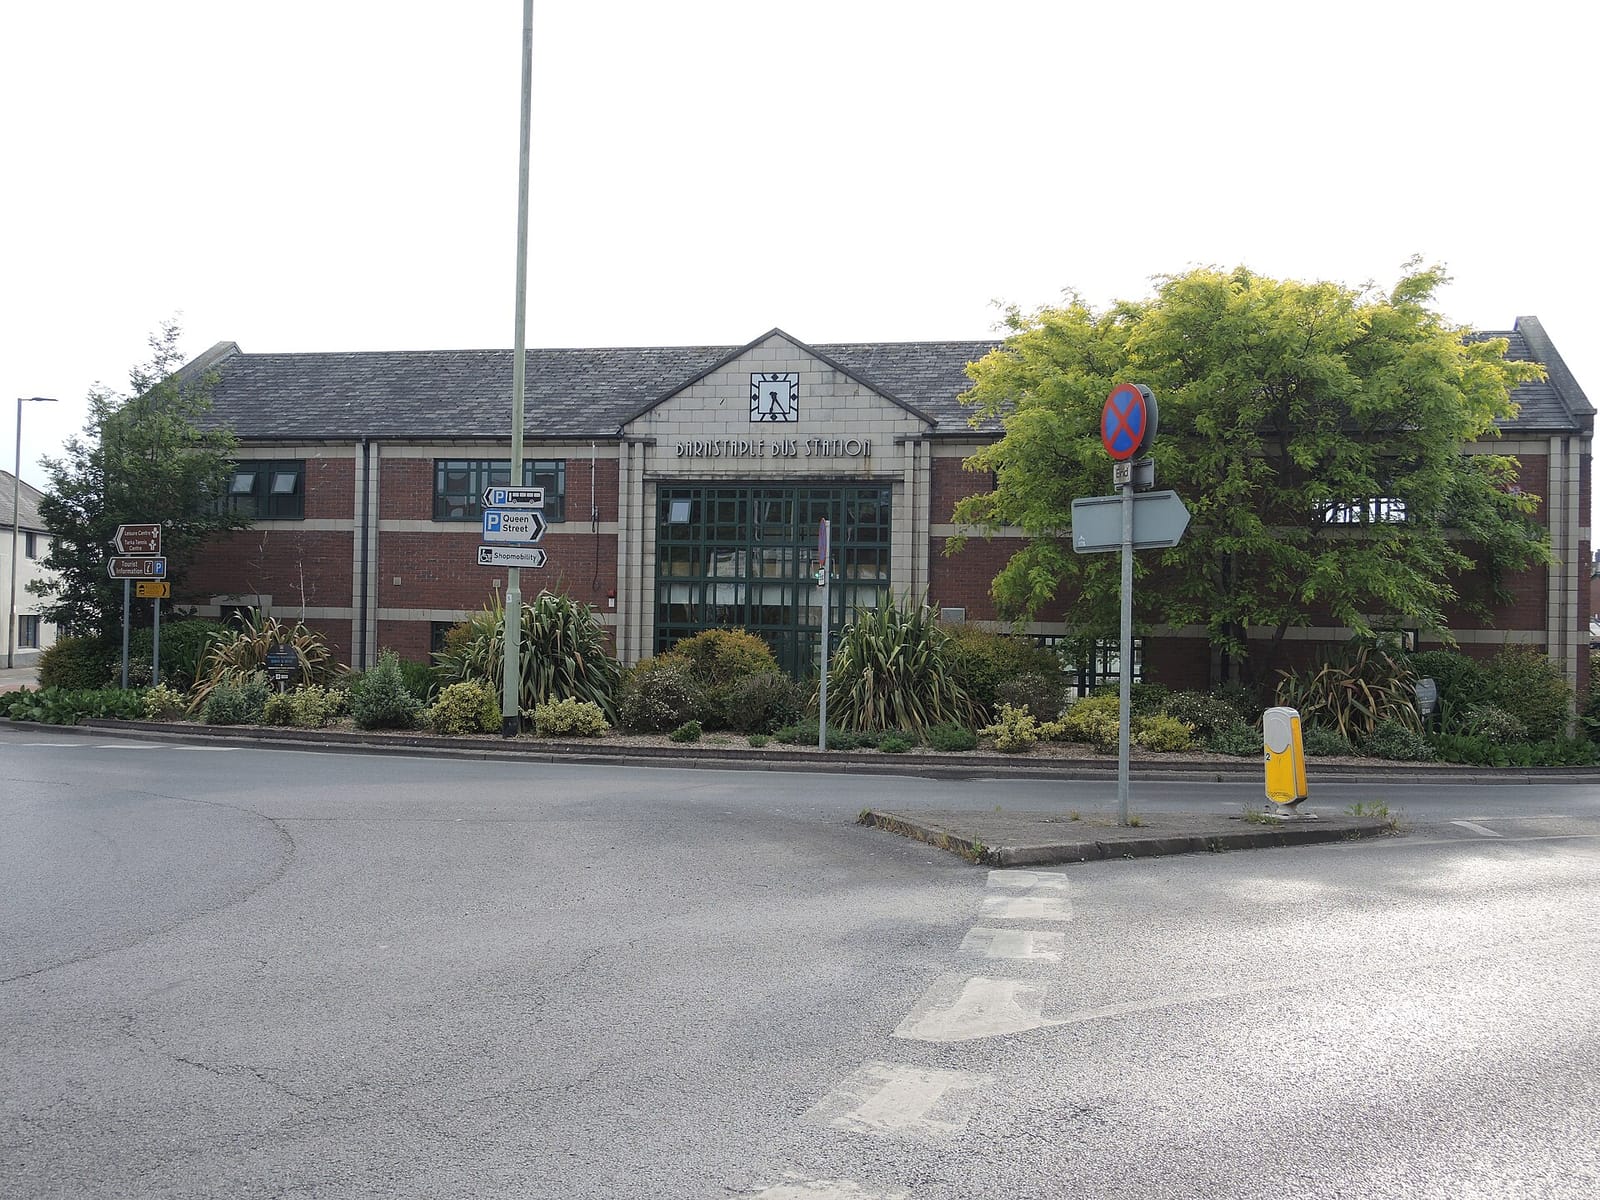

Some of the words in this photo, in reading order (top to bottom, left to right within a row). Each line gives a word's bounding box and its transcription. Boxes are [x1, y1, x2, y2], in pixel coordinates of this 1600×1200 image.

[675, 439, 764, 457] BARNSTAPLE
[771, 439, 797, 457] BUS
[805, 438, 872, 457] STATION
[1116, 466, 1129, 478] End
[495, 491, 505, 503] P
[487, 514, 499, 530] P
[503, 514, 529, 523] Queen
[502, 524, 529, 532] Street
[494, 551, 537, 563] Shopmobility
[116, 567, 143, 575] Information
[155, 562, 162, 573] P
[1265, 752, 1271, 761] 2
